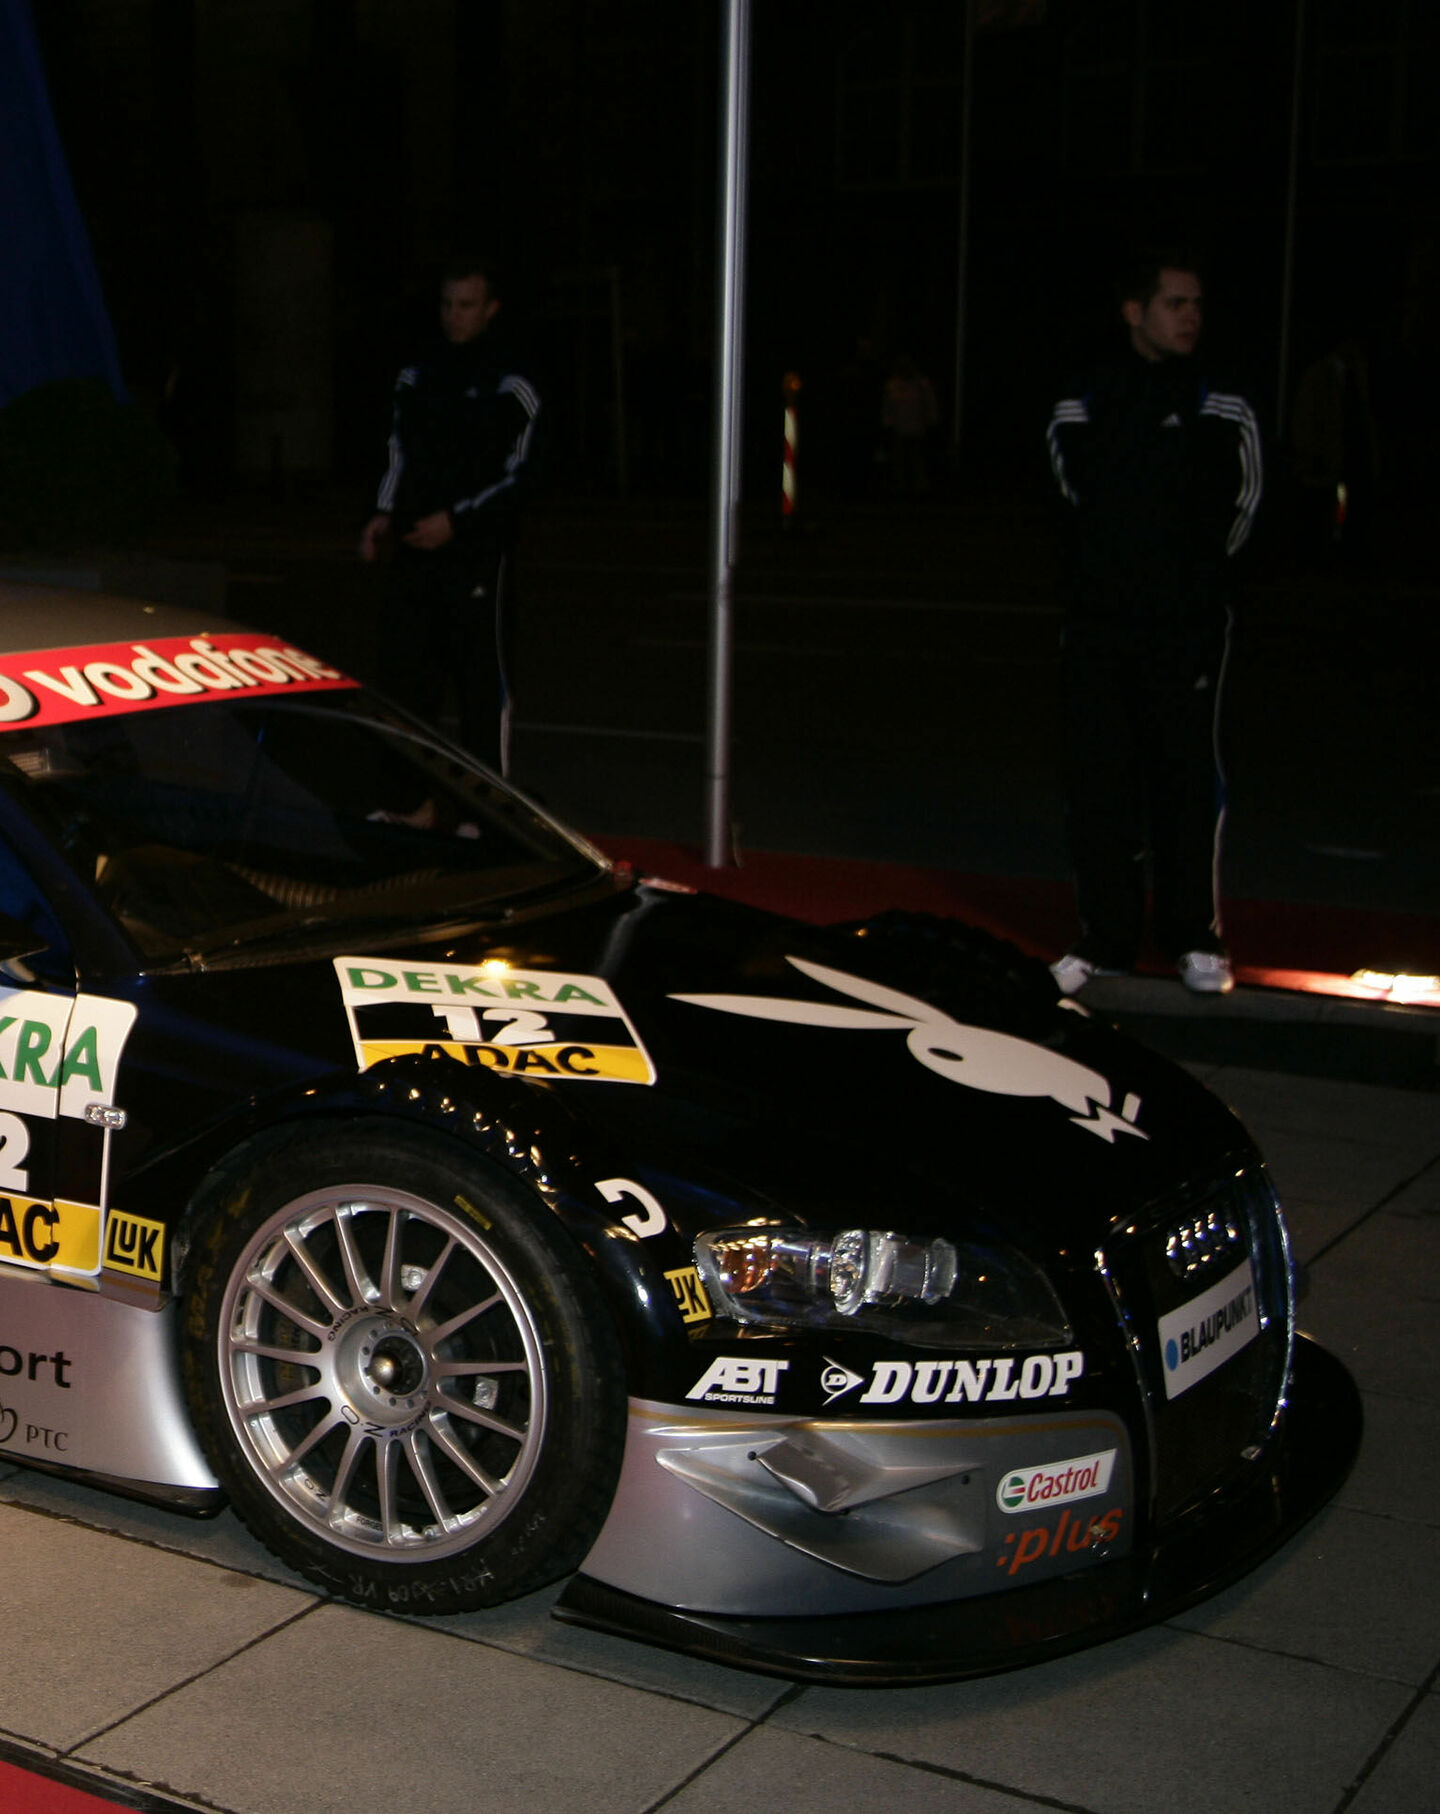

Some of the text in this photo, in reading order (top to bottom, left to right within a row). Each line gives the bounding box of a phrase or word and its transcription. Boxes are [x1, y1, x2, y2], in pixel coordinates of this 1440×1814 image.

[23, 638, 342, 706] vodafone
[345, 967, 609, 1007] DEKRA
[430, 1004, 556, 1046] 12
[419, 1043, 600, 1076] ADAC
[1180, 1285, 1252, 1364] BLAUPUNKT
[685, 1356, 790, 1400] ABT
[859, 1351, 1084, 1403] DUNLOP
[704, 1392, 775, 1405] SPORTSLINE
[25, 1423, 70, 1453] PTC
[1027, 1460, 1100, 1503] Castrol
